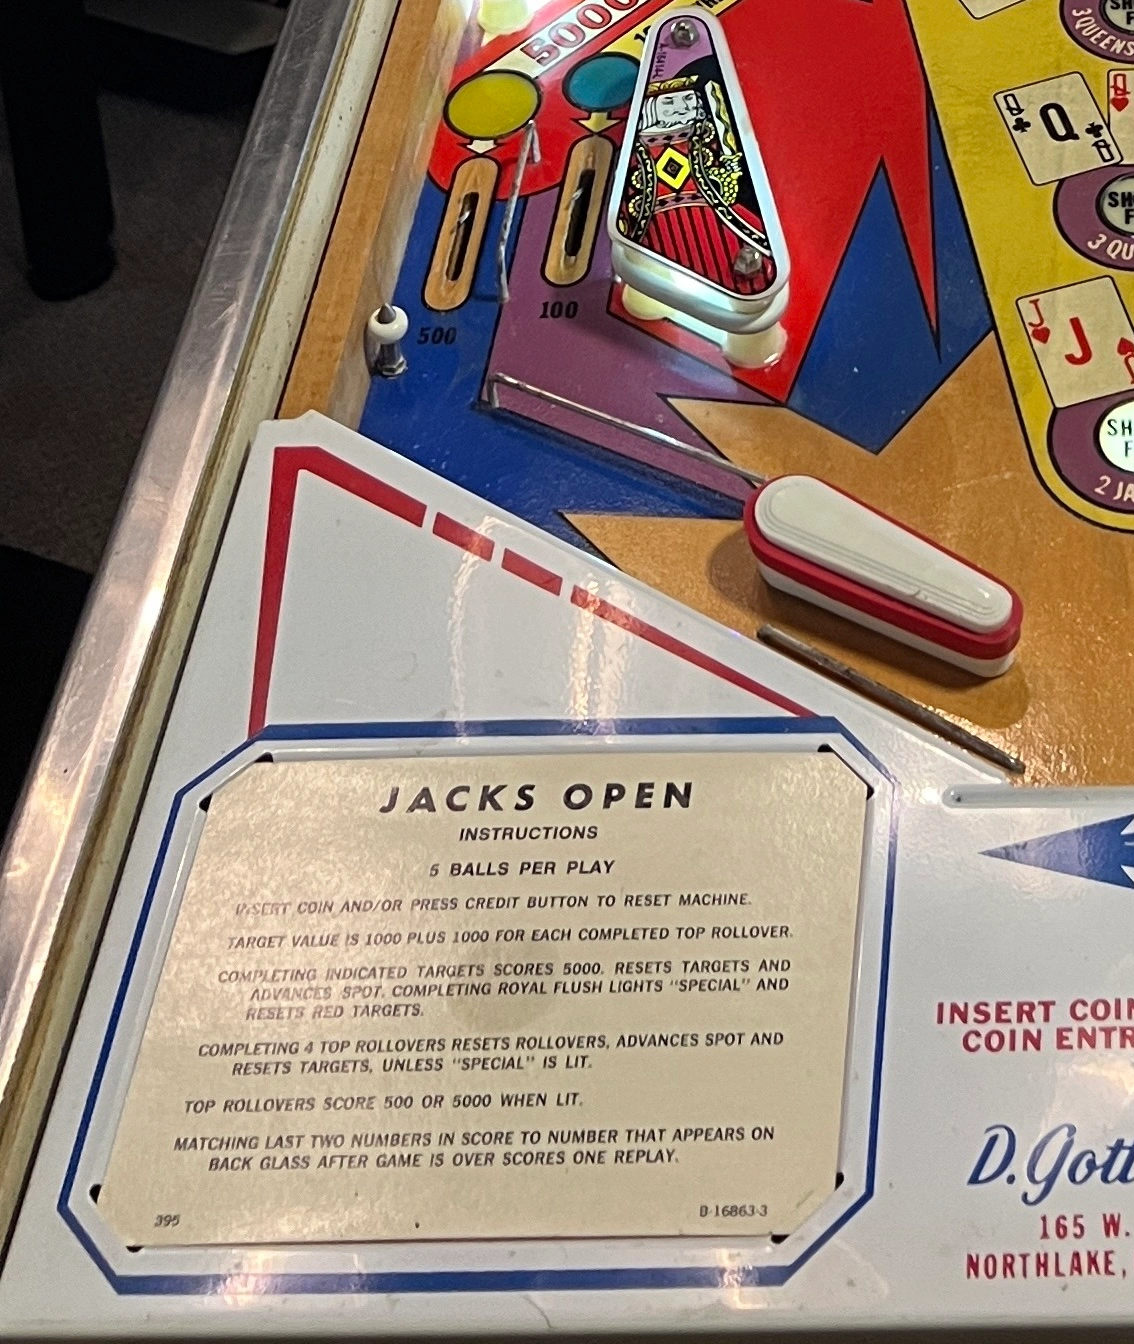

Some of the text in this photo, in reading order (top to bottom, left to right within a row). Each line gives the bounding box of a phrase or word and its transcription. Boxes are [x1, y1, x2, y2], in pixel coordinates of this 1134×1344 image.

[1072, 7, 1082, 18] 3
[1075, 16, 1134, 56] QUEENS
[1088, 234, 1106, 250] 3
[540, 301, 579, 319] 100
[417, 327, 457, 344] 500
[1094, 476, 1111, 495] 2
[379, 782, 692, 813] JACKS OPEN
[459, 826, 598, 840] INSTRUCTIONS
[429, 860, 615, 876] 5 BALLS PER PLAY
[937, 1000, 1056, 1024] INSERT
[962, 1029, 1042, 1052] COIN
[185, 1092, 583, 1114] TOP ROLLOVERS SCORE 500 OR 5000 WHEN LIT.
[154, 1215, 180, 1228] 395
[1040, 1215, 1085, 1240] 165
[1103, 1213, 1130, 1238] W.
[966, 1250, 1126, 1279] NORTHLAKE,
